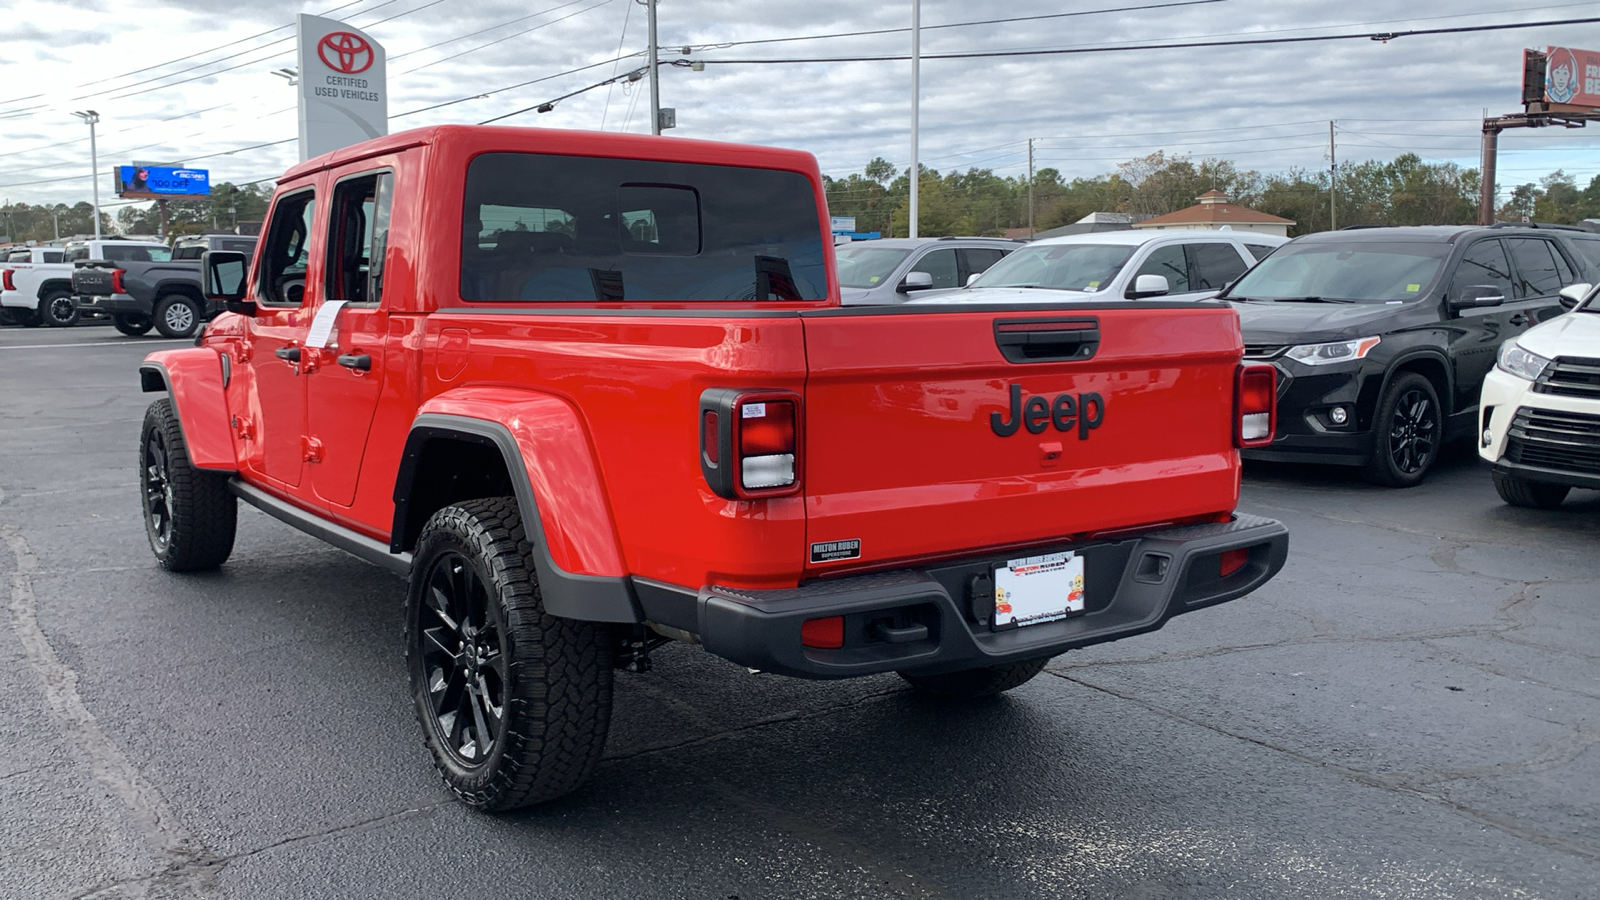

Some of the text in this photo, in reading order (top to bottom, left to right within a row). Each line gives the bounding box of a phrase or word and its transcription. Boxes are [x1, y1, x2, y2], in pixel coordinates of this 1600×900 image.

[326, 75, 368, 88] CERTIFIED
[315, 86, 379, 102] USED VEHICLES
[990, 383, 1104, 440] Jeep
[813, 540, 859, 553] MILTON RUBEN
[1040, 561, 1065, 570] RUBEN
